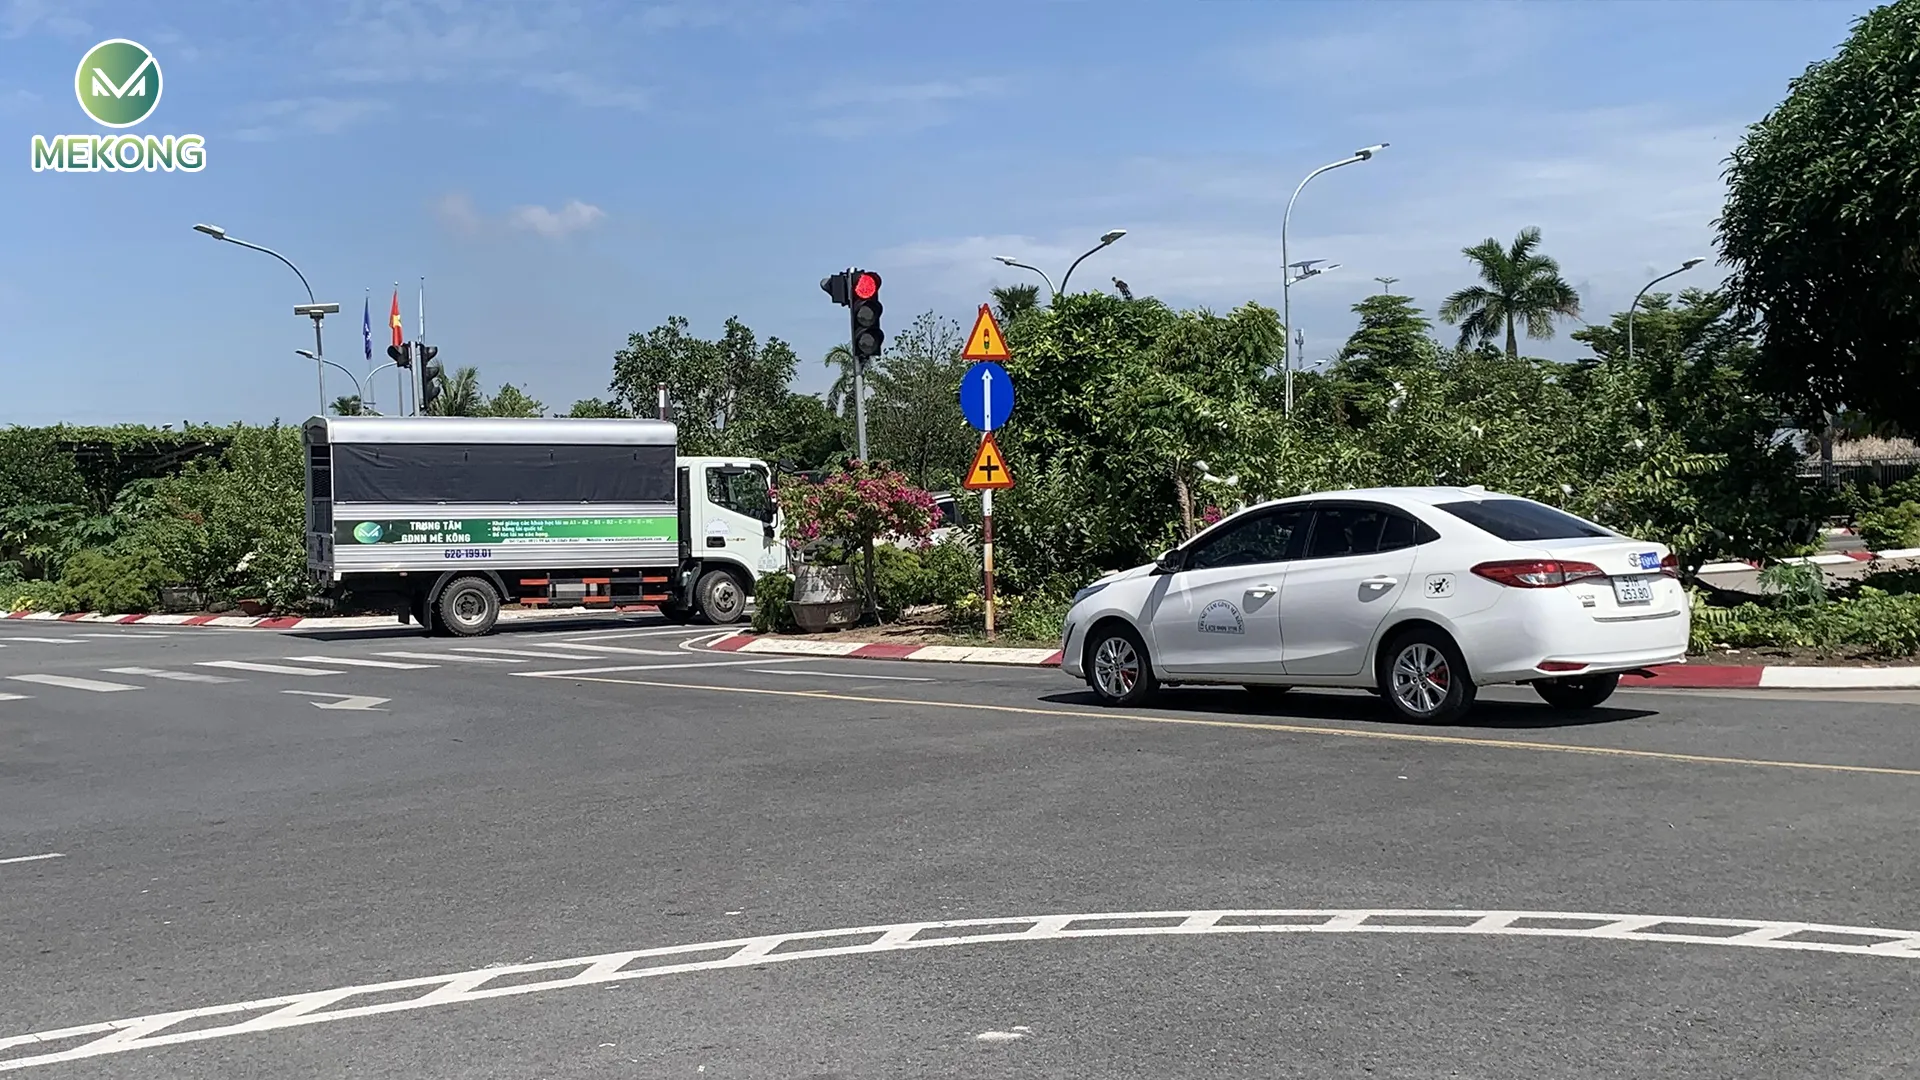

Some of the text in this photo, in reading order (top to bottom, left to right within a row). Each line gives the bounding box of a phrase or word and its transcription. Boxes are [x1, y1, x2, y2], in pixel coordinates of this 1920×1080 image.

[443, 520, 462, 530] TÂM
[401, 533, 471, 543] GDNN MÊ KÔNG
[444, 548, 492, 559] 62C-199.01
